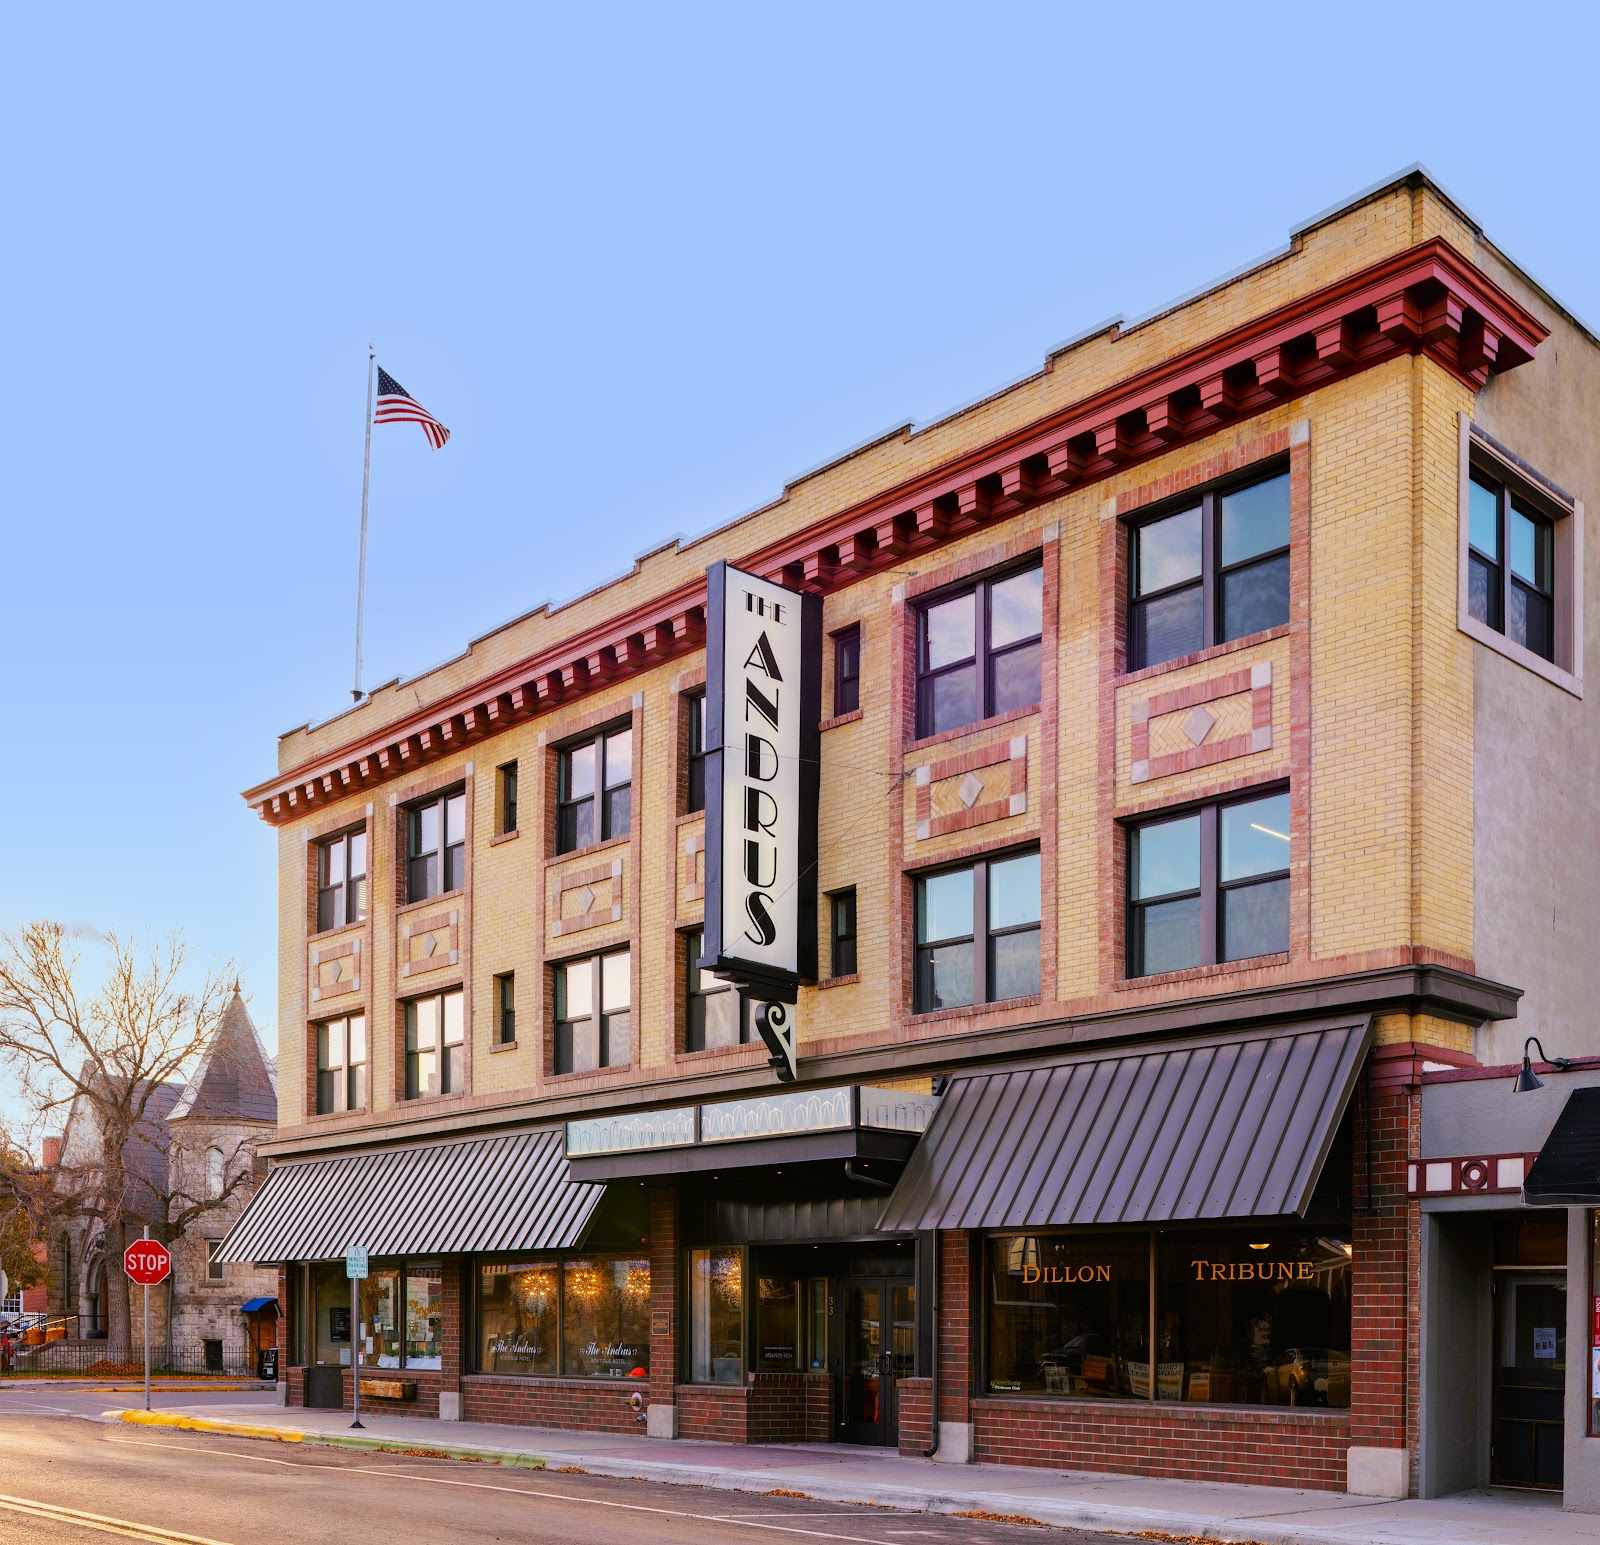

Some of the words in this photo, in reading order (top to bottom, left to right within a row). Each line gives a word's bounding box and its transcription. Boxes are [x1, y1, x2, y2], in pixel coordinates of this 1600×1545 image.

[742, 589, 787, 626] THE
[743, 629, 784, 946] ANDRUS
[127, 1253, 168, 1271] STOP
[1022, 1264, 1111, 1284] DILLON
[1190, 1260, 1315, 1281] TRIBUNE
[496, 1340, 508, 1353] The
[509, 1340, 537, 1354] Andrus
[586, 1341, 601, 1355] The
[601, 1342, 632, 1356] Andrus
